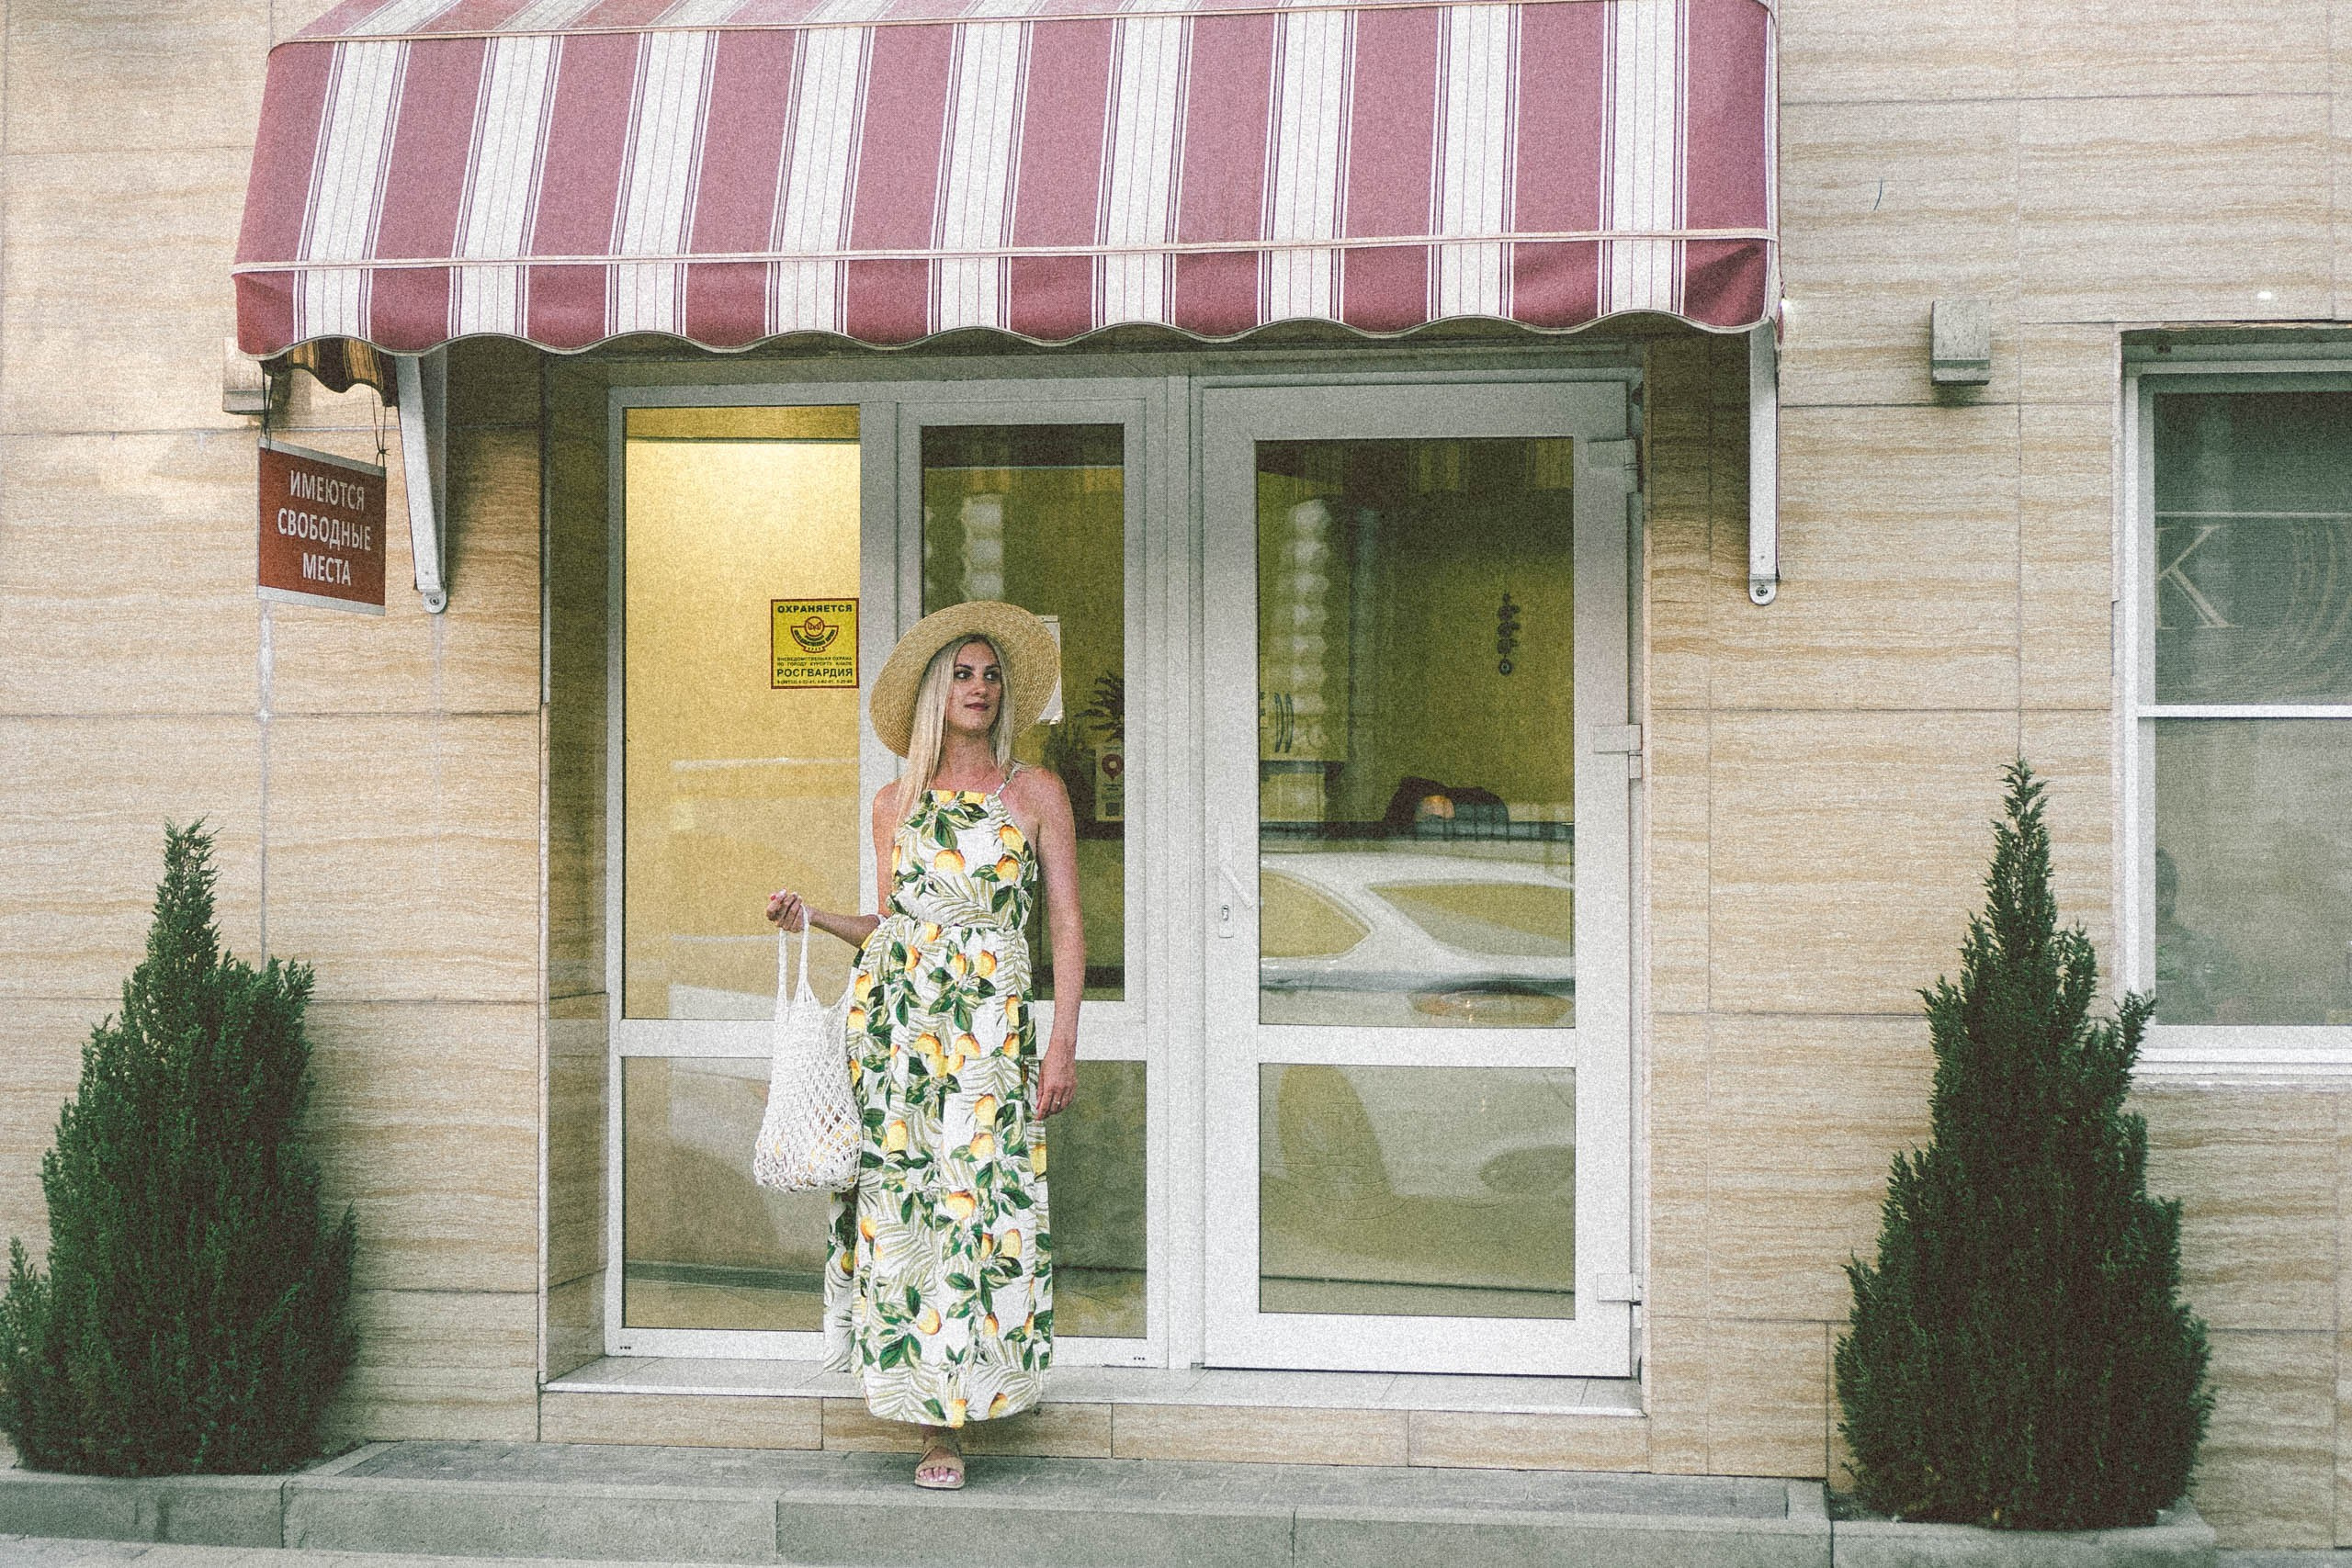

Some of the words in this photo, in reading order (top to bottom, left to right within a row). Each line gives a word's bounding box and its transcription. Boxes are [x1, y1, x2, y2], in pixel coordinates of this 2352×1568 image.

[290, 469, 365, 511] ИМЕЮТСЯ
[277, 508, 371, 551] СВОБОДНЫЕ
[302, 553, 352, 587] МЕСТА
[777, 604, 853, 614] ОХРАНЯЕТСЯ
[777, 669, 853, 678] РОСГВАРДИЯ
